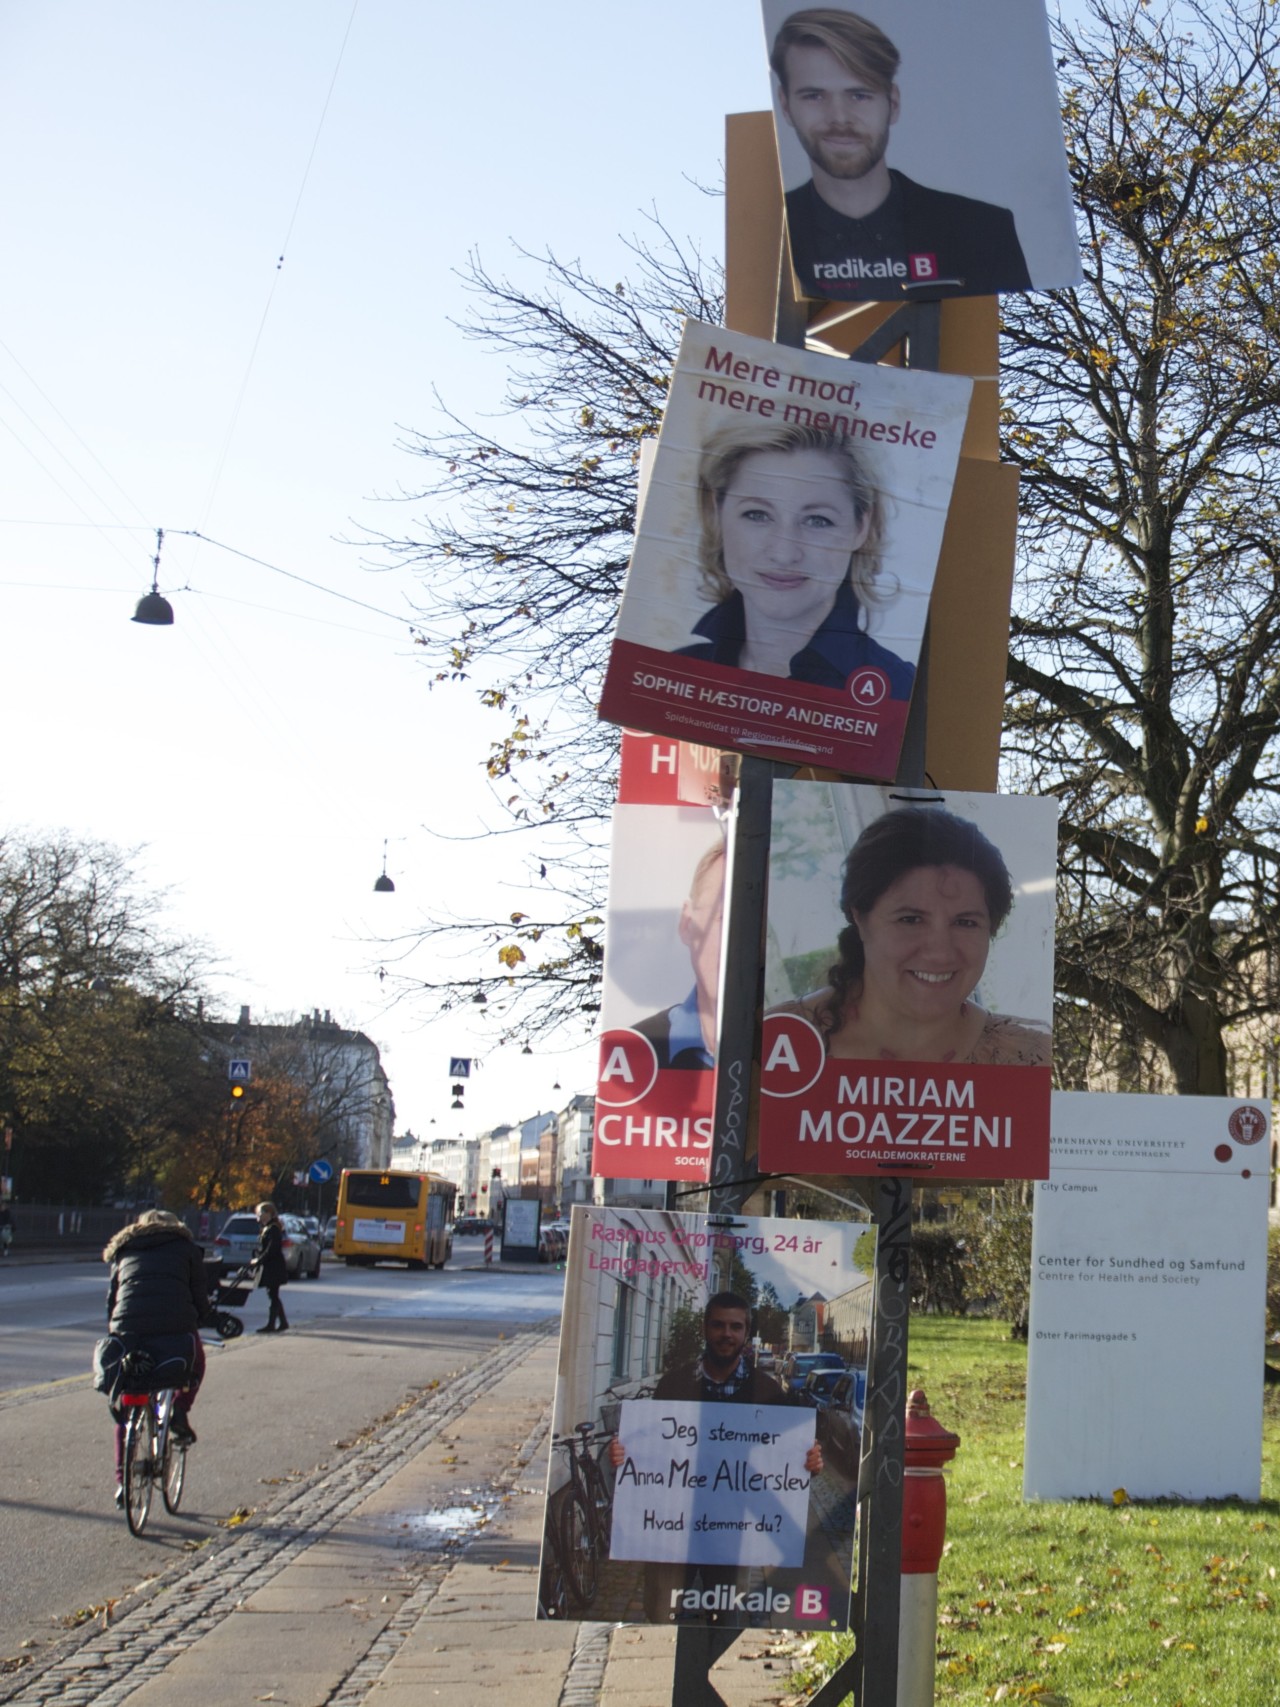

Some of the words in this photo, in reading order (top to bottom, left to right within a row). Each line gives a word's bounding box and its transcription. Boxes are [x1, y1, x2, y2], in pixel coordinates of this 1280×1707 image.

[813, 257, 907, 280] radikale
[914, 257, 934, 277] B
[704, 345, 780, 387] Mere
[788, 375, 861, 411] mod,
[698, 380, 775, 417] mere
[783, 404, 937, 449] menneske
[860, 680, 875, 697] A
[632, 671, 696, 699] SOPHIE
[699, 687, 783, 717] HÆSTORP
[786, 706, 878, 736] ANDERSEN
[665, 711, 729, 733] Spidskandidat
[730, 725, 739, 735] til
[651, 744, 677, 774] H
[600, 1046, 634, 1083] A
[764, 1034, 801, 1072] A
[837, 1075, 976, 1109] MIRIAM
[598, 1115, 712, 1149] CHRIS
[798, 1109, 1013, 1149] MOAZZENI
[845, 1149, 966, 1162] SOCIALDEMOKRATERNE
[1097, 1149, 1109, 1157] OF
[1112, 1150, 1171, 1158] COPENHAGEN
[1117, 1139, 1186, 1149] UNIVERSITET
[1041, 1182, 1059, 1192] City
[1062, 1183, 1098, 1193] Campus
[591, 1223, 666, 1244] Rasmus
[774, 1234, 798, 1252] 24
[803, 1235, 823, 1254] år
[588, 1254, 709, 1281] Langagervej
[1038, 1255, 1081, 1267] Center
[1086, 1256, 1104, 1268] for
[1109, 1256, 1164, 1269] Sundhed
[1169, 1260, 1185, 1271] og
[1190, 1259, 1245, 1271] Samfund
[1038, 1272, 1074, 1281] Centre
[1079, 1272, 1094, 1282] for
[1099, 1273, 1134, 1283] Health
[1138, 1274, 1158, 1283] and
[1162, 1274, 1200, 1286] Society
[1036, 1331, 1060, 1340] Øster
[1064, 1331, 1128, 1342] Farimagsgade
[661, 1417, 698, 1446] Jeg
[708, 1422, 780, 1445] stemmer
[618, 1457, 664, 1486] Anna
[668, 1458, 708, 1488] Mee
[712, 1459, 810, 1492] Allerslev
[643, 1509, 684, 1531] Hvad
[694, 1513, 752, 1532] stemmer
[755, 1514, 783, 1533] du?
[670, 1584, 791, 1613] radikale
[801, 1589, 823, 1614] B
